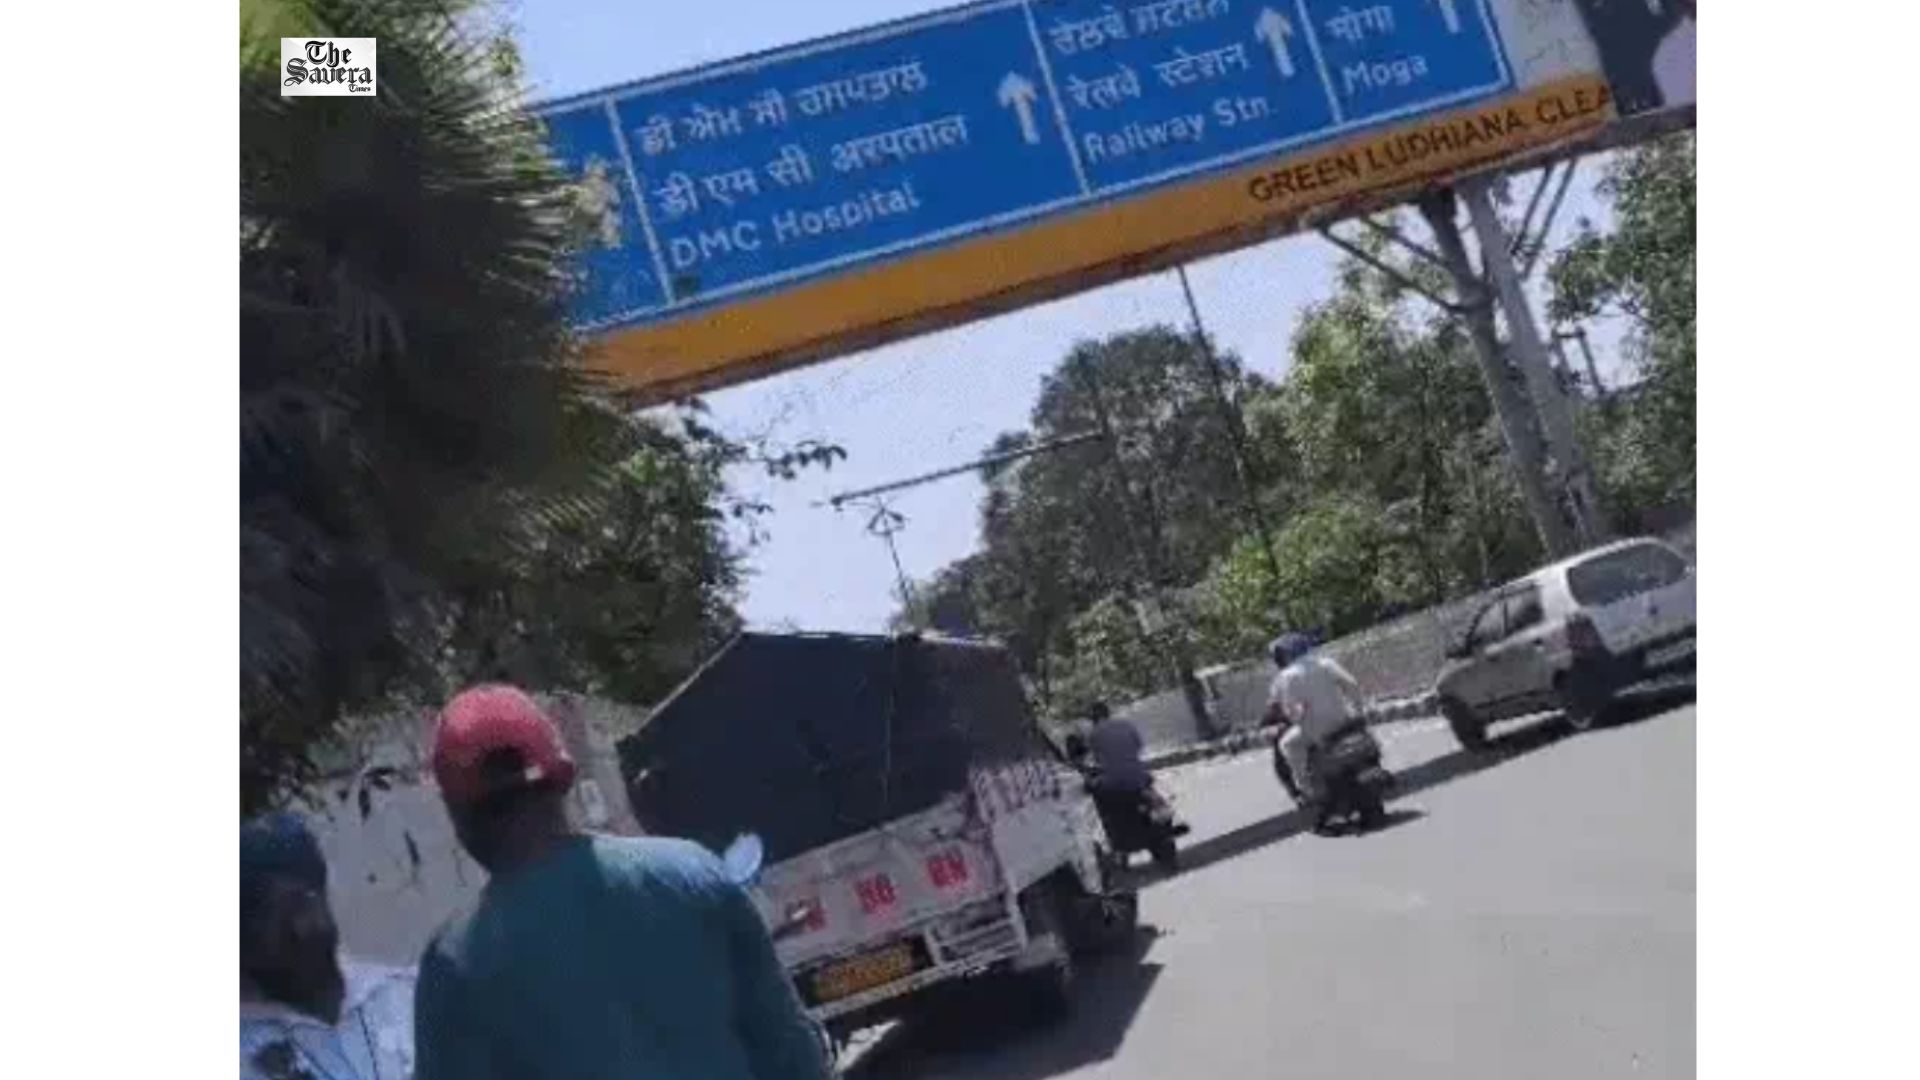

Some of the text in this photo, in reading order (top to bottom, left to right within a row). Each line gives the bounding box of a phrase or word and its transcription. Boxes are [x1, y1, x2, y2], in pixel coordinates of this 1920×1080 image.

[1066, 42, 1250, 110] रेलवे स्टेशन
[1342, 54, 1429, 95] Moga
[654, 113, 969, 219] डी एम सी अस्पताल
[1082, 115, 1207, 165] Railway
[1248, 153, 1360, 202] GREEN
[1366, 110, 1524, 168] LUDHIANA
[669, 182, 922, 270] DMC Hospital
